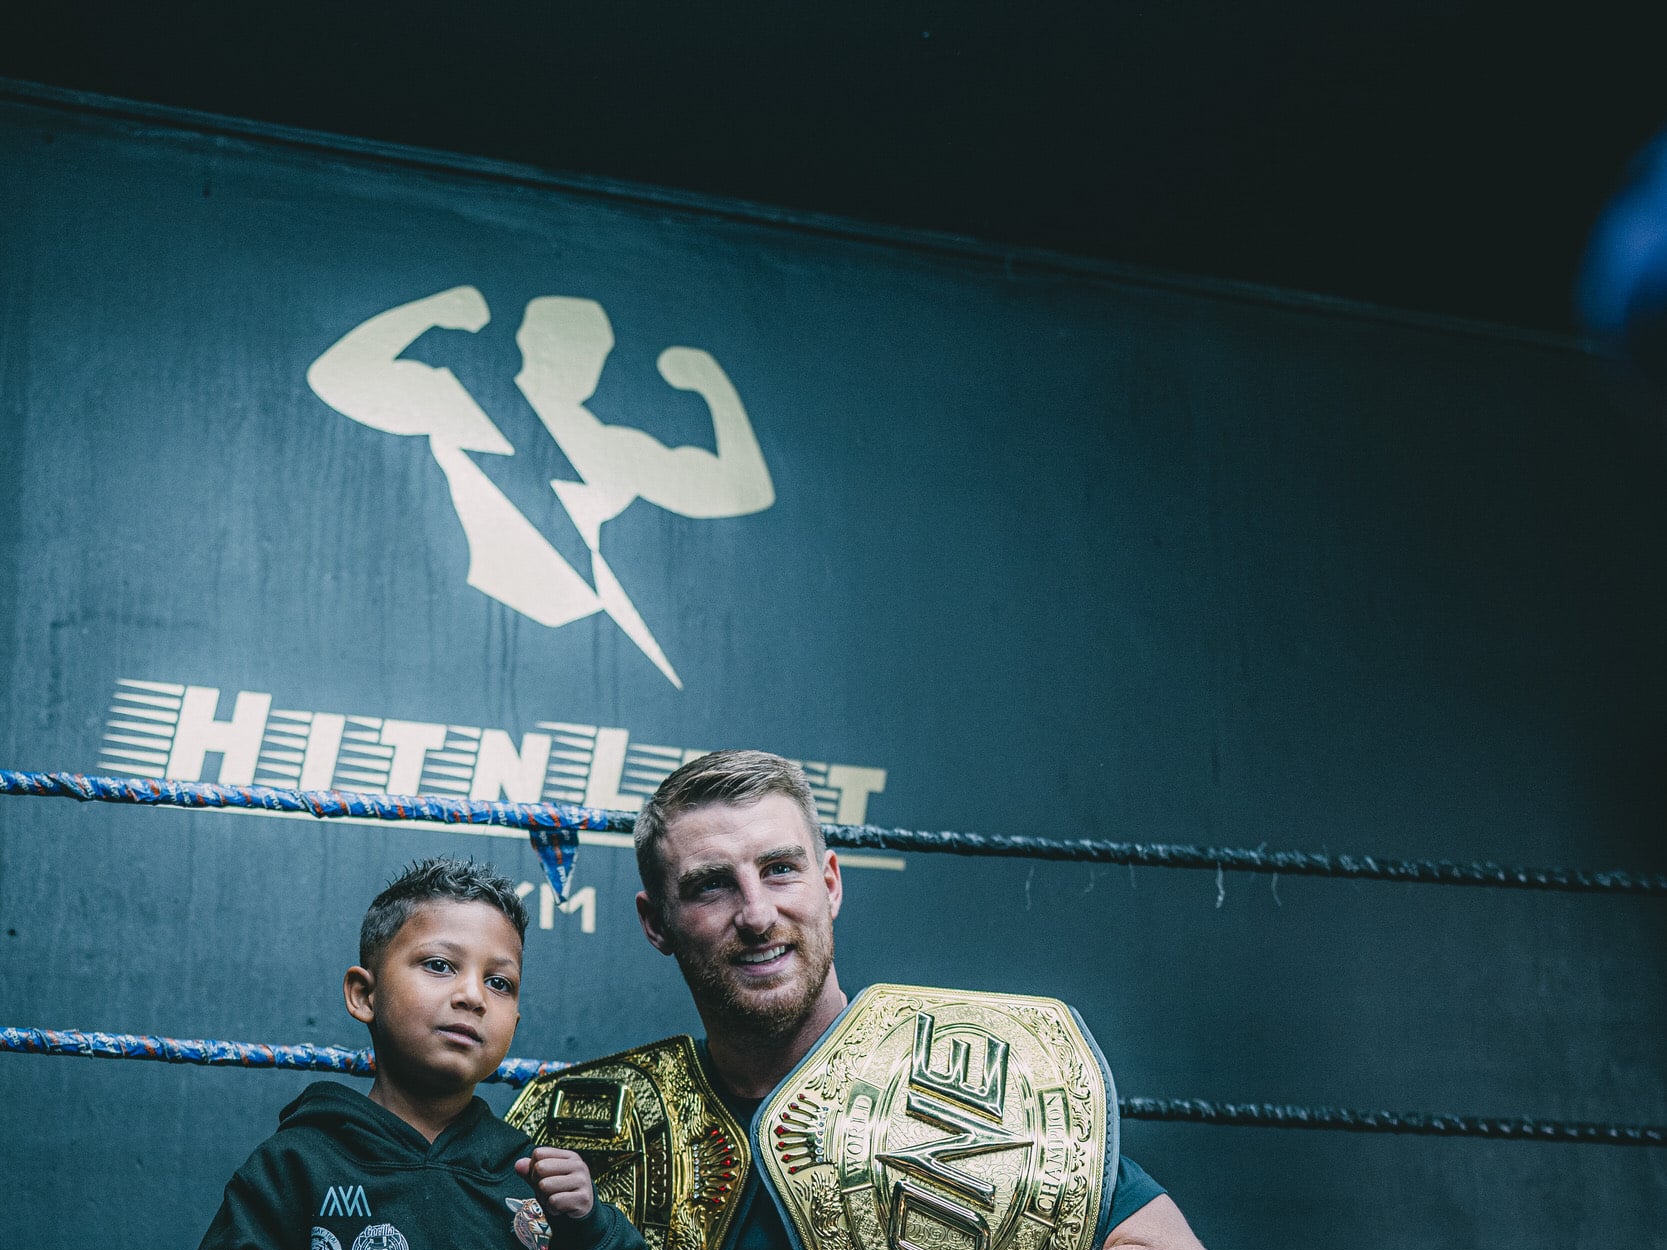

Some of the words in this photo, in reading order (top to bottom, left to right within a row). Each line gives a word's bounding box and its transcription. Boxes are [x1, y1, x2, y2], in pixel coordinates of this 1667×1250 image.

[165, 686, 887, 826] HITNLT
[846, 1094, 874, 1176] WORLD
[1034, 1094, 1066, 1214] CHAMPION
